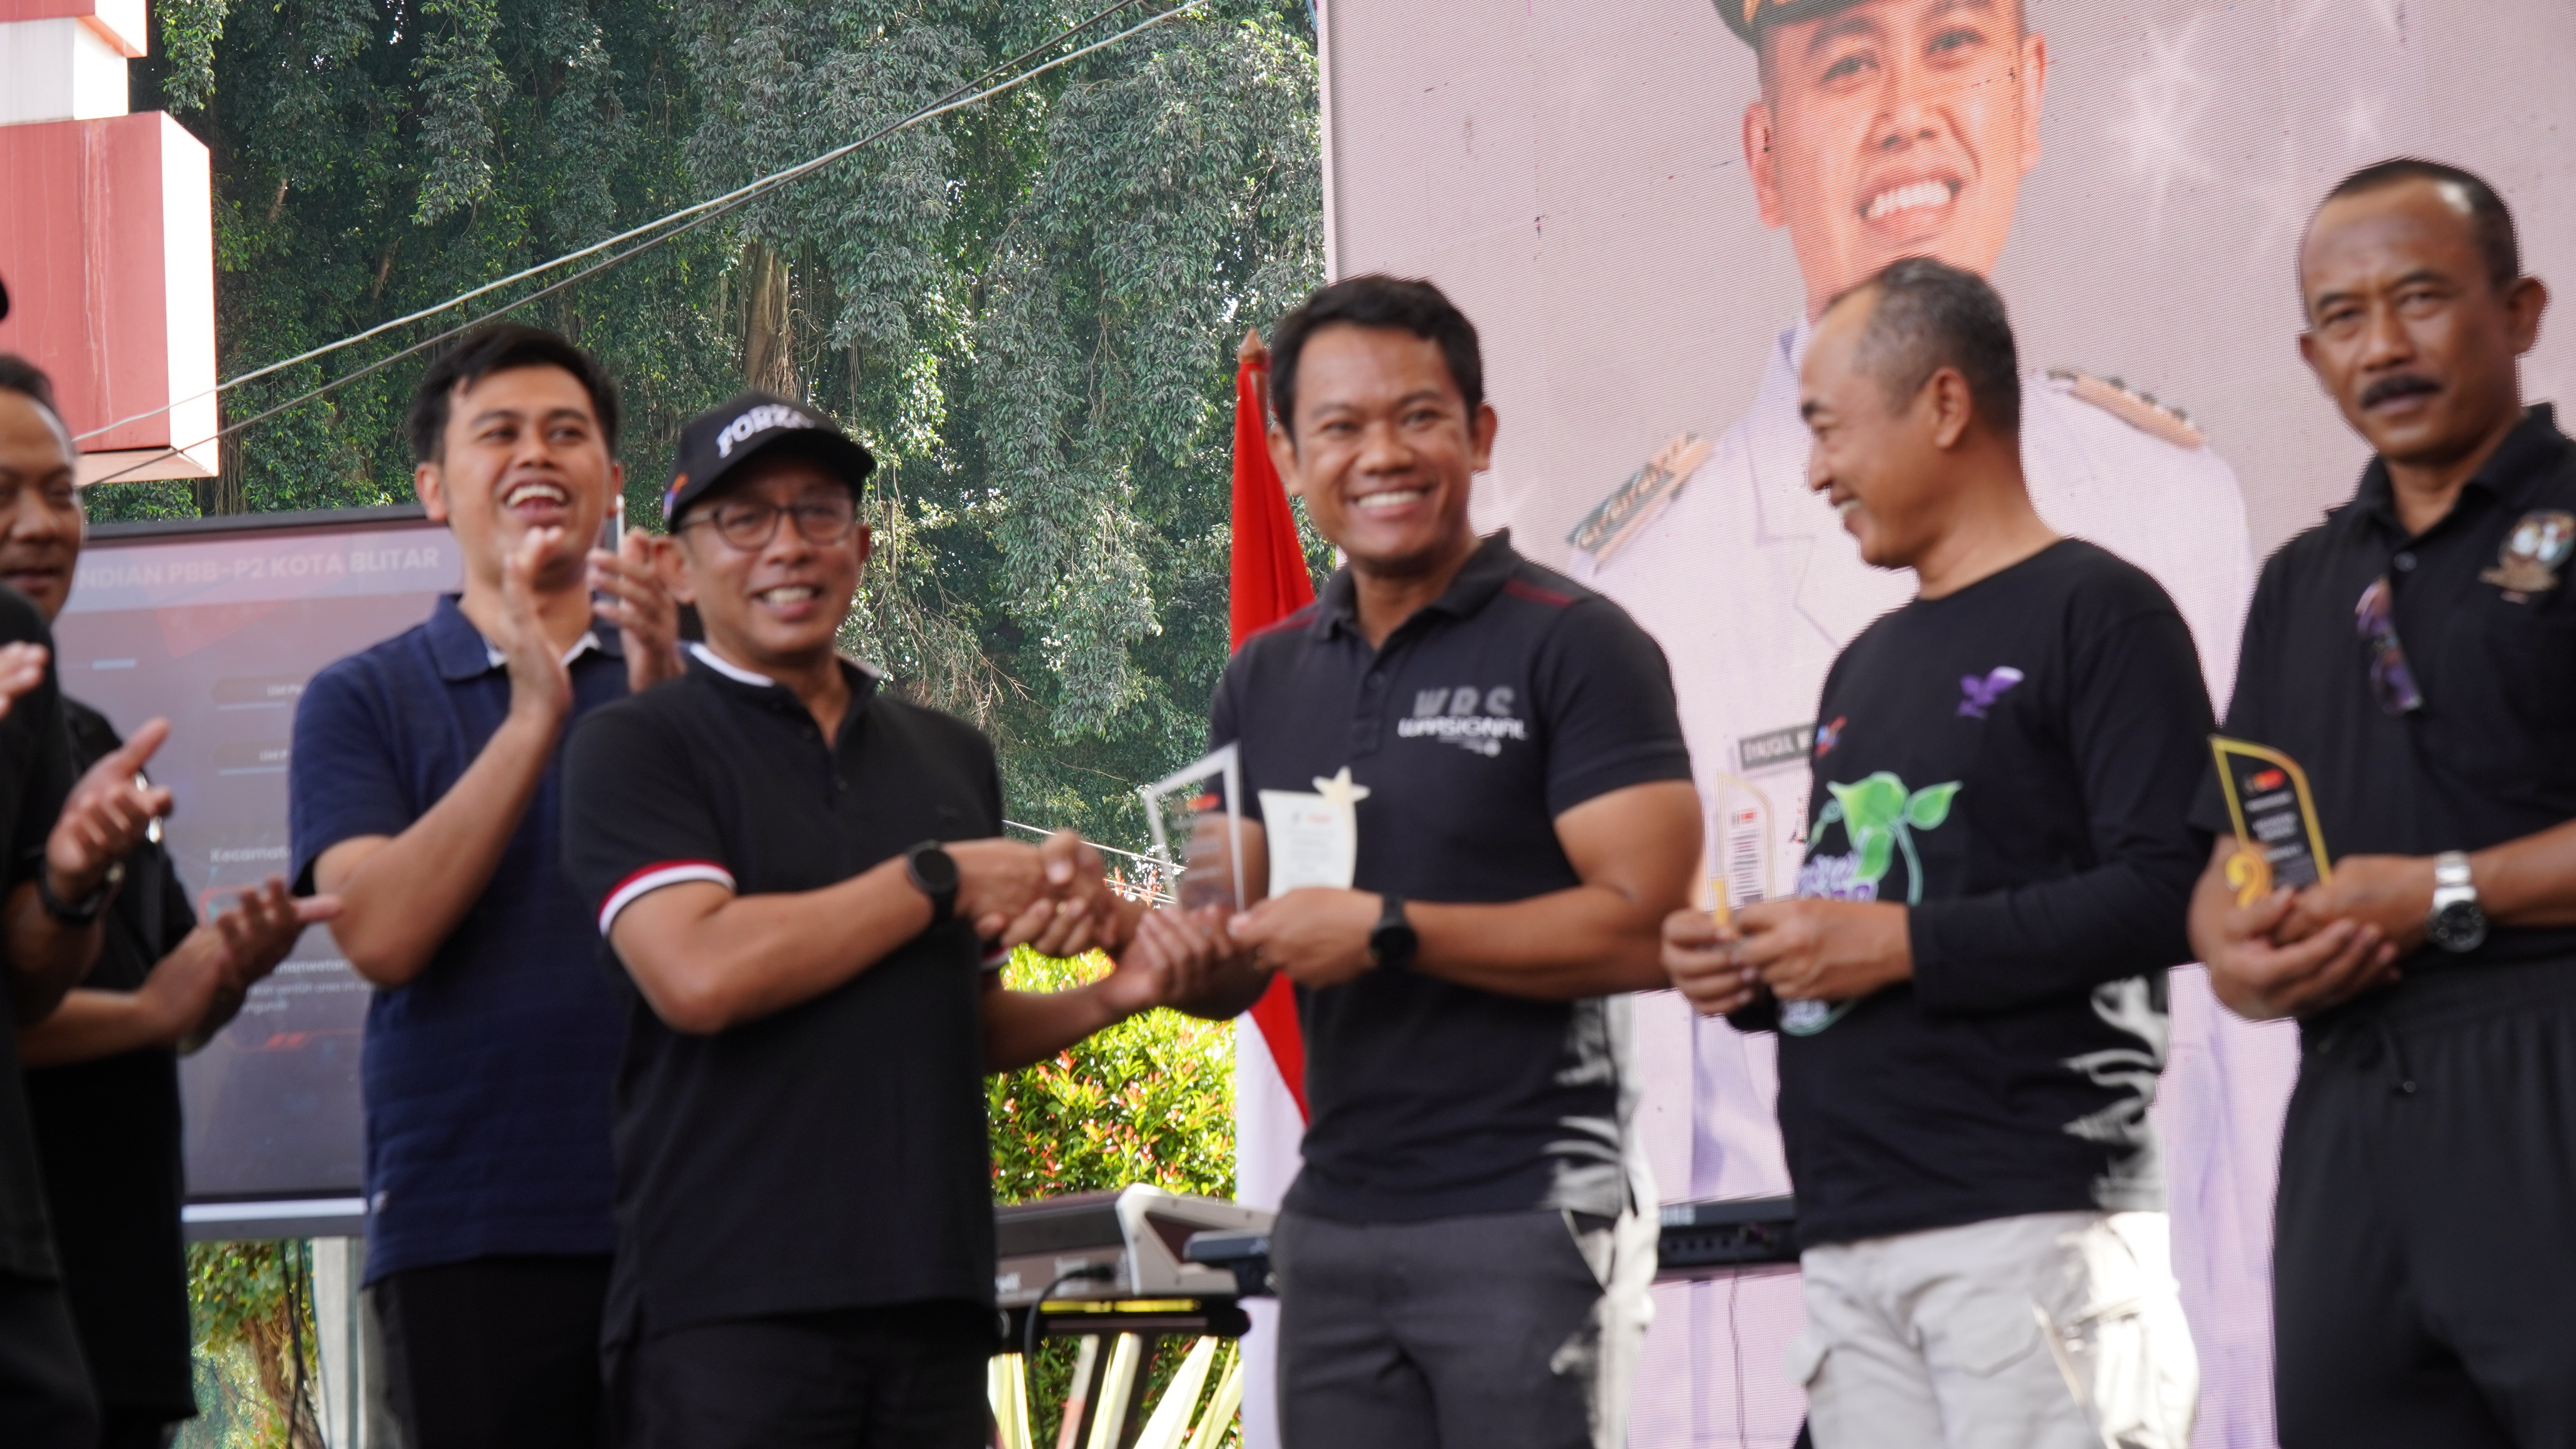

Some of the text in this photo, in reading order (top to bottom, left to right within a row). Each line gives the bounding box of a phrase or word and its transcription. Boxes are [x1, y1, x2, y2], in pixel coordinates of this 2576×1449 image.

[79, 547, 440, 588] NDIAN PBB-P2 KOTA BLITAR
[210, 846, 289, 862] Kecamat
